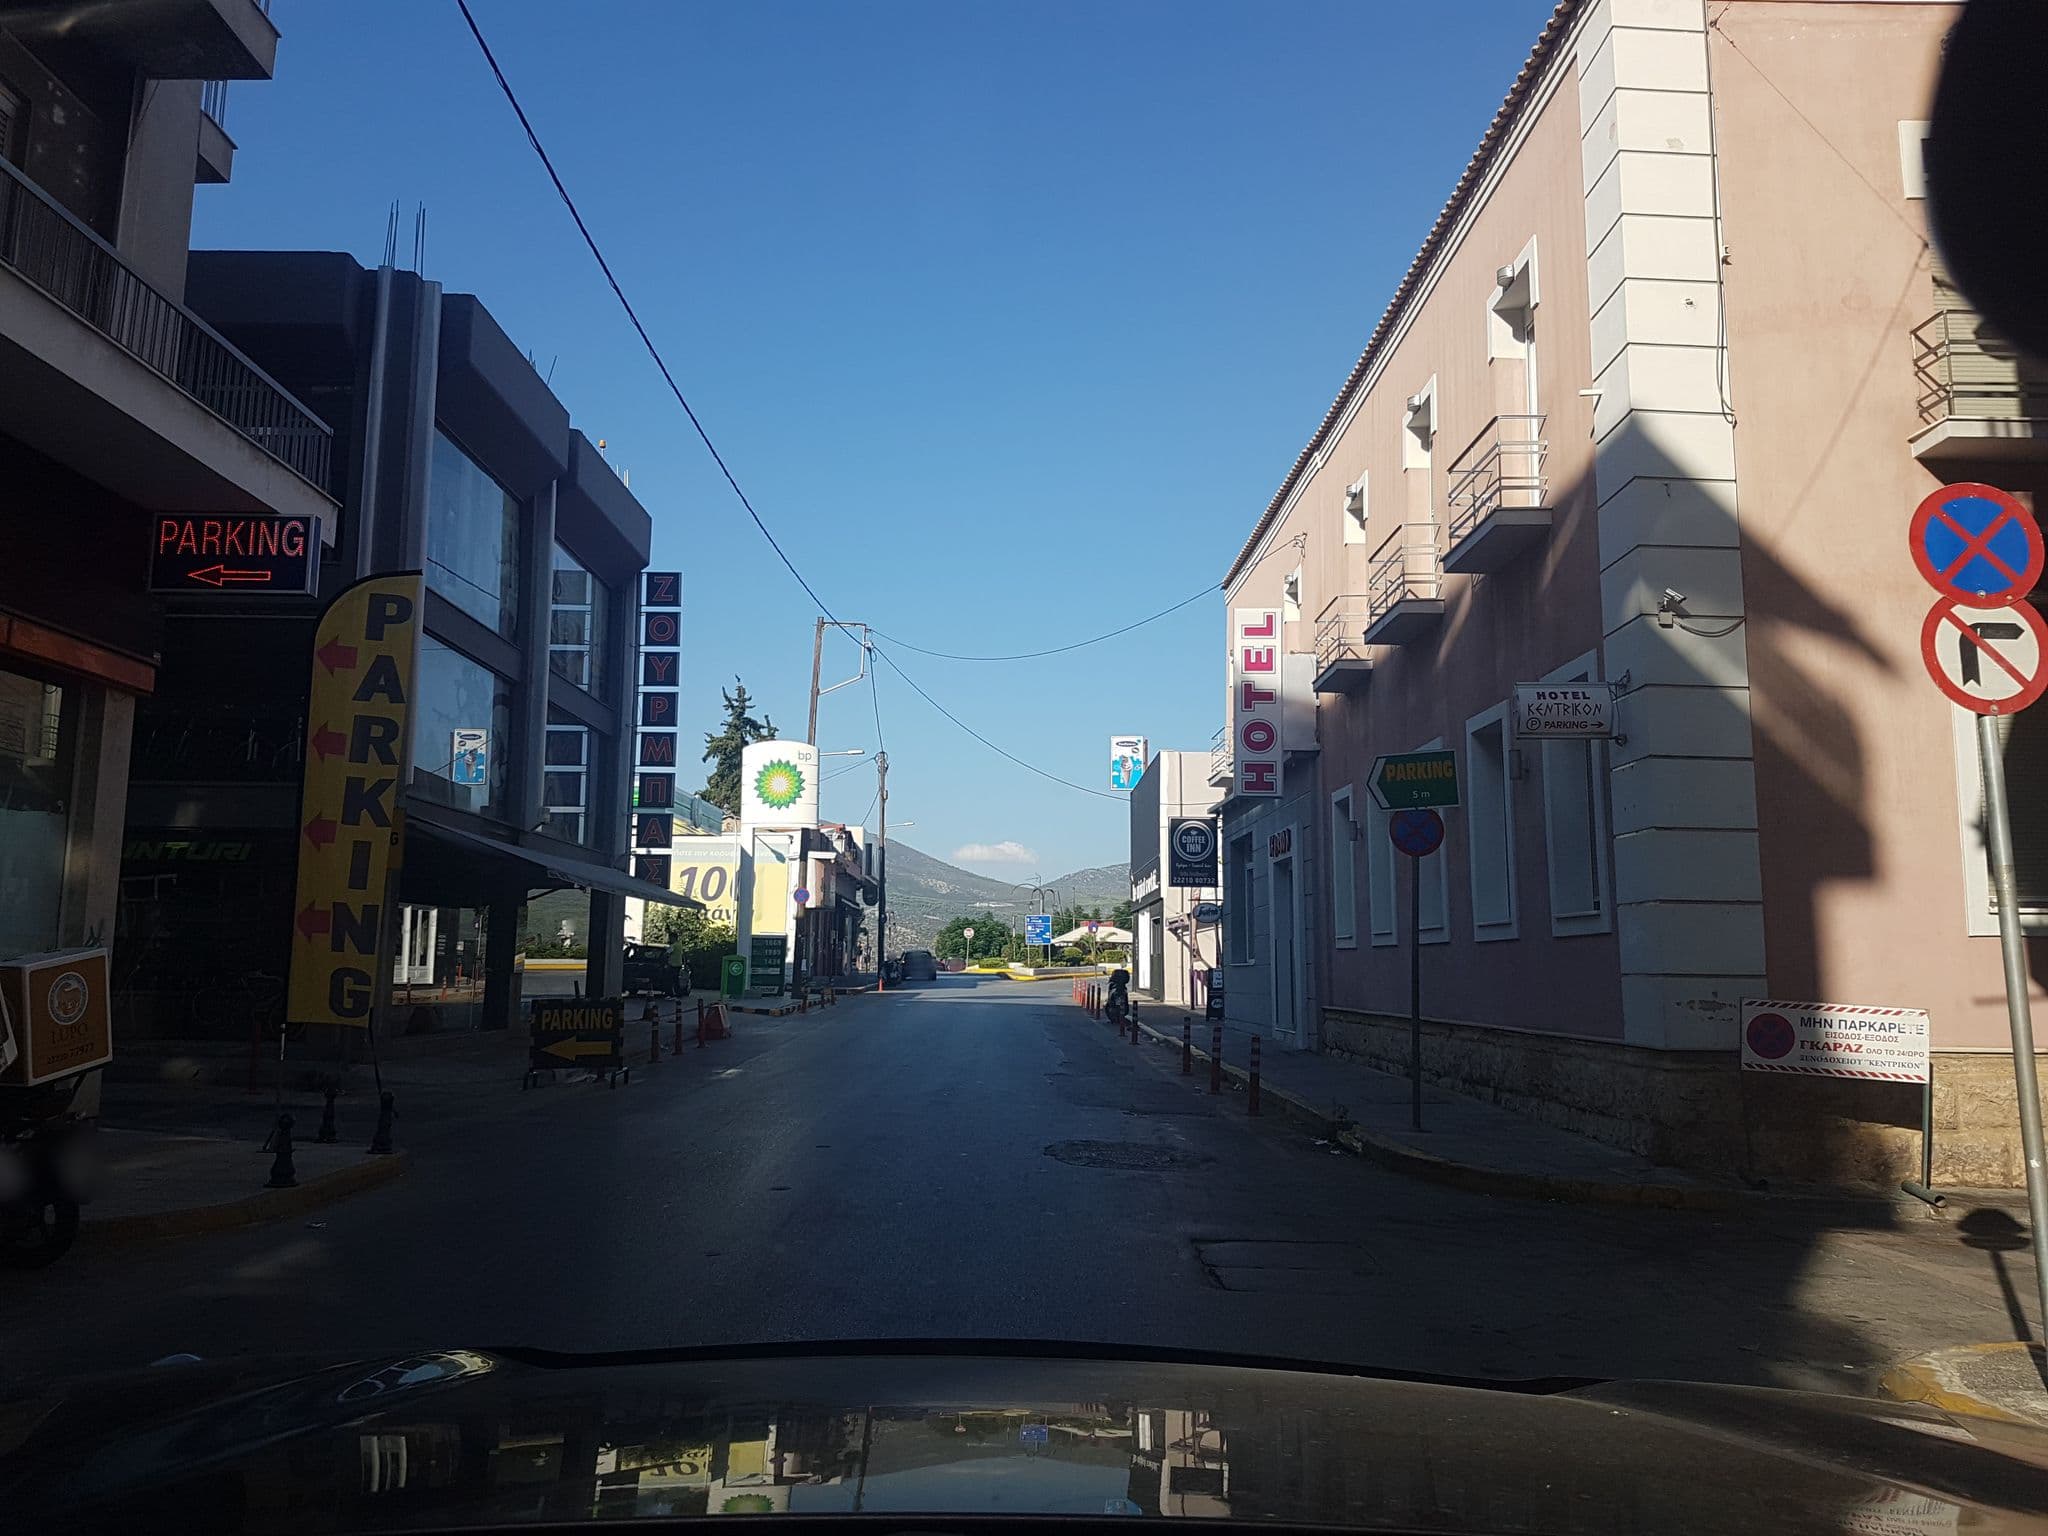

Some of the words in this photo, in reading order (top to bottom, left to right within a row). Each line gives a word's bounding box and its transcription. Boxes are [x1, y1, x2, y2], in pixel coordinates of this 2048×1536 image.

[160, 520, 305, 557] PARKING
[1241, 612, 1278, 793] HOTEL
[1536, 691, 1591, 701] HOTEL
[1527, 702, 1602, 717] KENTRIKON
[642, 576, 675, 885] ΖΟΥΡΜΠΑΣ
[1544, 720, 1588, 729] PARKING
[798, 750, 812, 762] bp
[1385, 760, 1453, 781] PARKING
[1412, 790, 1419, 799] 5
[329, 593, 413, 1018] PARKING
[1182, 835, 1206, 844] COFFEE
[1186, 844, 1201, 853] INN
[542, 1008, 614, 1031] PARKING
[1800, 1016, 1833, 1029] ΜΗΝ
[1824, 1031, 1899, 1043] ΕΙΣΟΔΟΣ-ΕΞΟΔΟΣ
[1800, 1040, 1864, 1054] ΓΚΑΡΑΖ
[1866, 1047, 1882, 1055] ΟΛΟ
